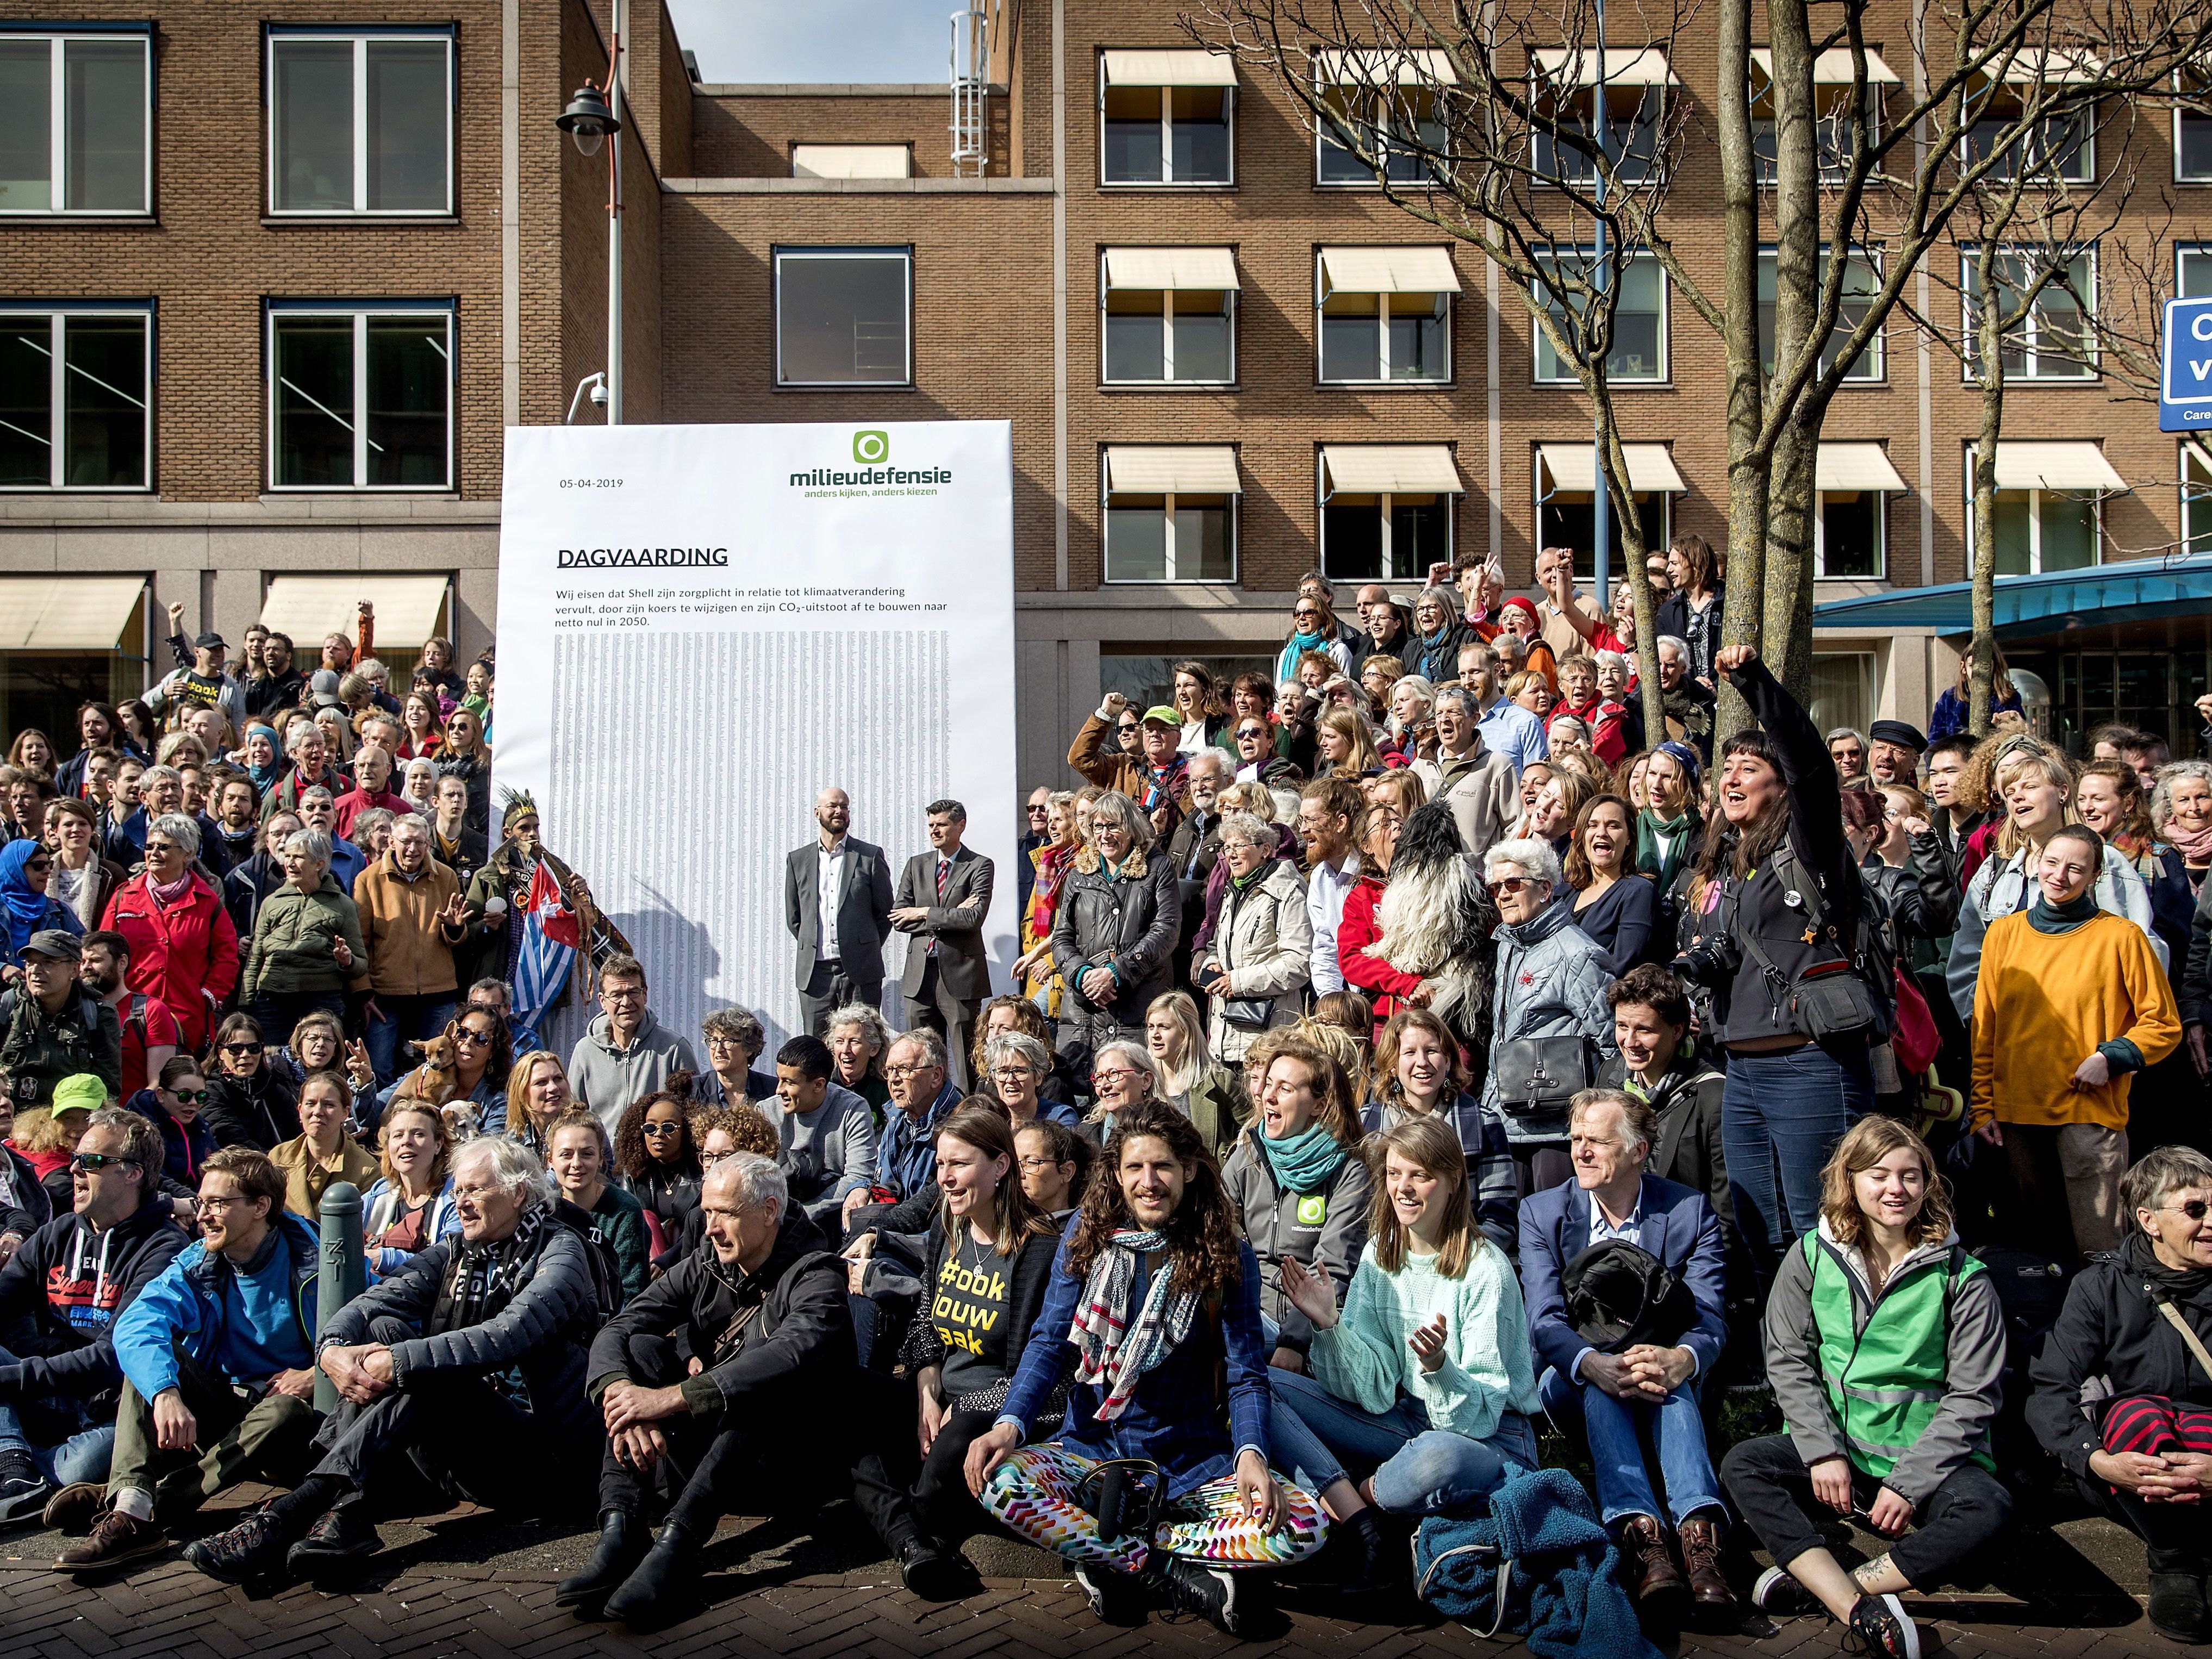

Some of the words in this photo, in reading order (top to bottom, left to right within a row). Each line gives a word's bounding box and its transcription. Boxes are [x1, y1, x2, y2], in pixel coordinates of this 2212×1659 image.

[2183, 410, 2212, 420] Care
[790, 466, 952, 486] milieudefensie
[560, 479, 623, 488] 05-04-2019
[805, 489, 837, 498] anders
[839, 489, 870, 499] kijken,
[872, 488, 905, 496] anders
[907, 488, 937, 496] kiezen
[557, 548, 728, 567] DAGVAARDING
[556, 590, 574, 601] Wij
[577, 590, 605, 599] eisen
[608, 589, 625, 598] dat
[628, 588, 653, 598] Shell
[657, 588, 675, 600] zijn
[679, 588, 731, 599] zorgplicht
[735, 588, 744, 597] in
[748, 588, 781, 597] relatie
[785, 588, 800, 596] tot
[804, 587, 905, 597] klimaatverandering
[555, 604, 595, 614] vervult,
[599, 604, 624, 614] door
[626, 604, 644, 615] zijn
[648, 604, 677, 613] koers
[681, 604, 691, 613] te
[694, 603, 737, 614] wijzigen
[757, 603, 775, 614] zijn
[851, 602, 861, 612] af
[864, 603, 875, 612] te
[878, 602, 920, 611] bouwen
[555, 619, 583, 627] netto
[587, 618, 602, 627] nul
[607, 617, 615, 626] in
[620, 616, 650, 626] 2050.
[939, 1257, 1005, 1301] #ook
[931, 1287, 998, 1331] jouw
[933, 1324, 985, 1356] aak
